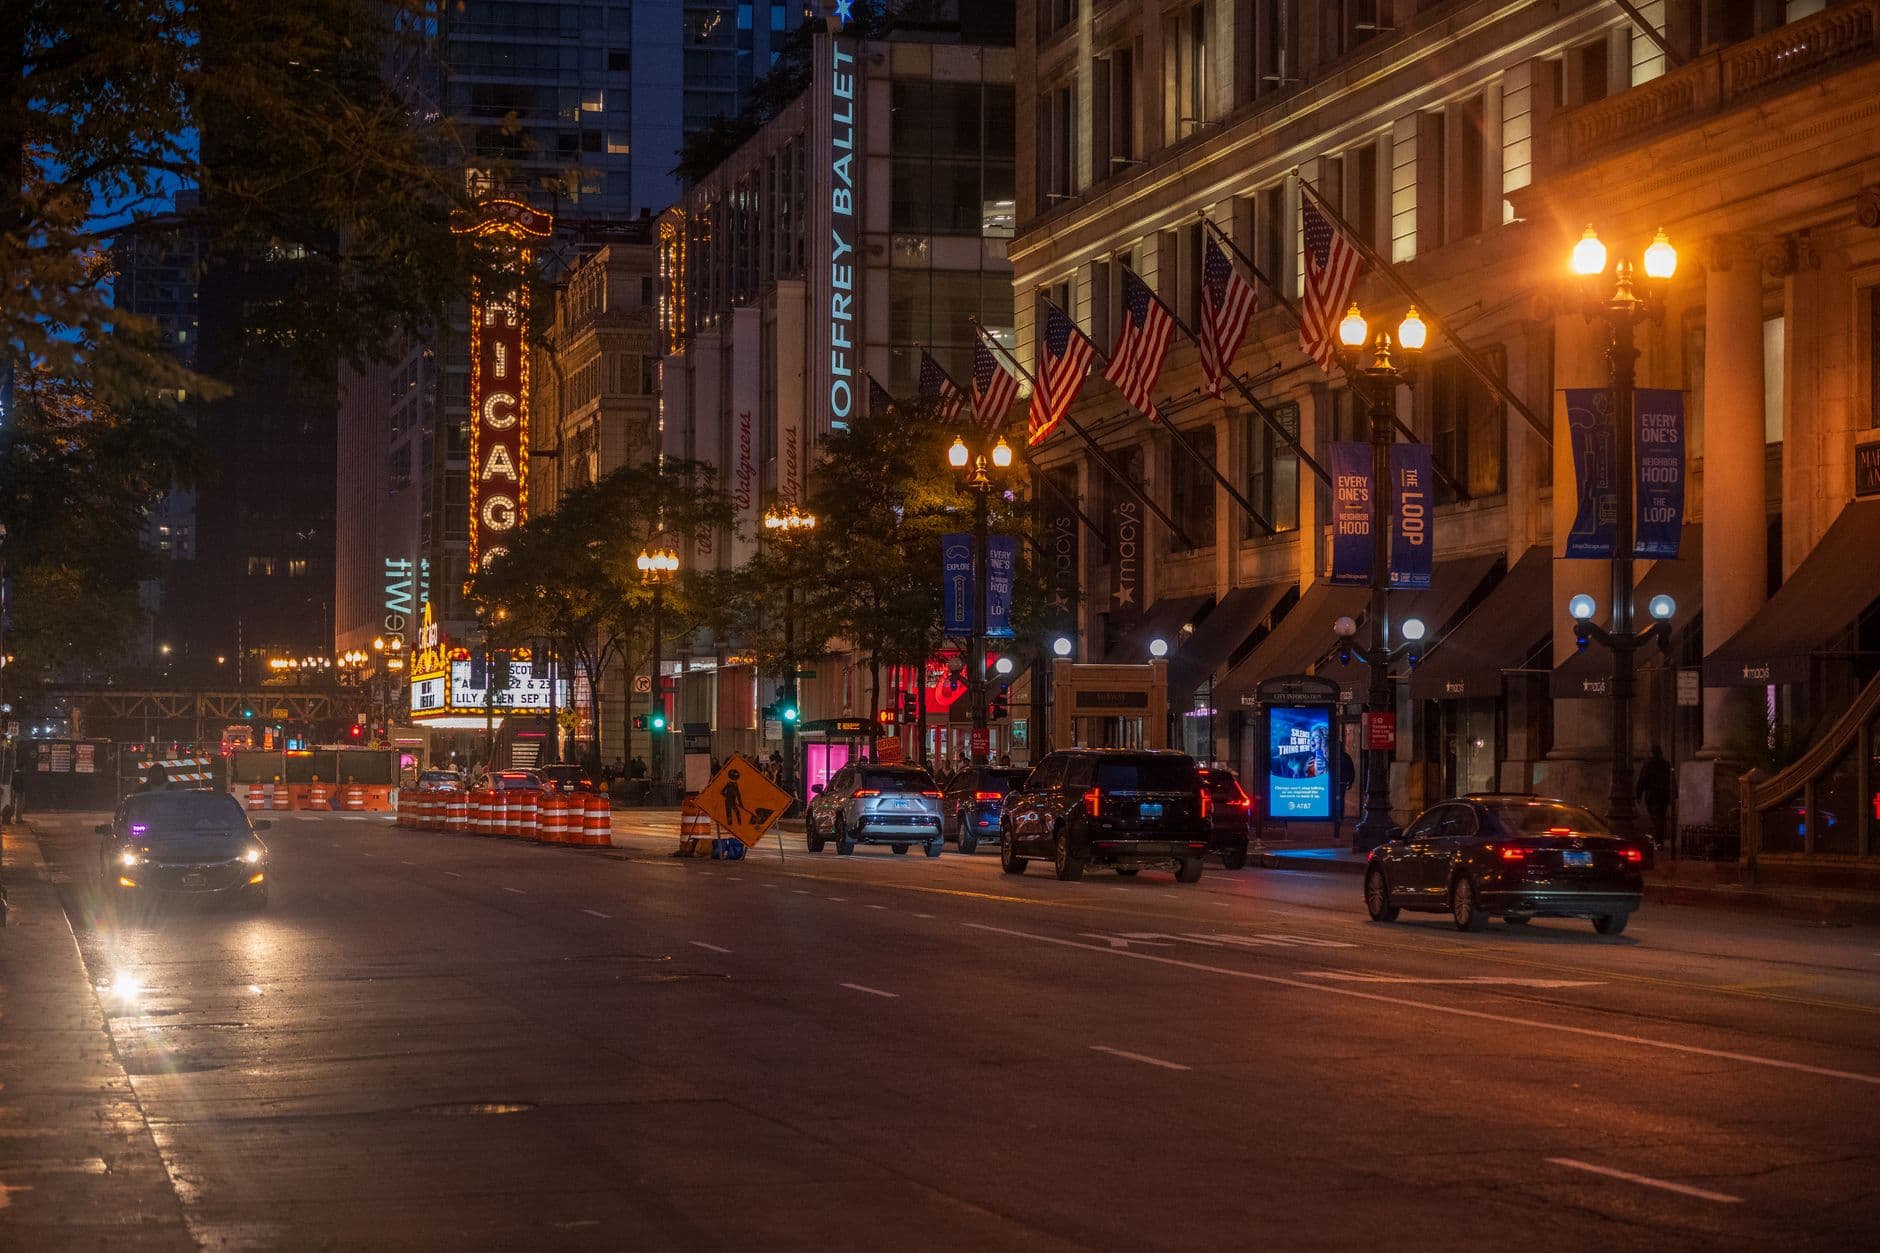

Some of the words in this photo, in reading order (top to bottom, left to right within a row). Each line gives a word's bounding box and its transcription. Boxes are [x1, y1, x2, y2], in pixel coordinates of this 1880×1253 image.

[832, 41, 855, 215] BALLET
[831, 232, 853, 434] JOFFREY
[481, 246, 517, 577] HICAG
[1641, 414, 1677, 427] EVERY
[1641, 428, 1678, 443] ONE'S
[732, 410, 757, 510] Walgreens
[1641, 458, 1678, 466] NEIGHBOR
[1338, 476, 1368, 487] EVERY
[1406, 469, 1418, 487] THE
[1641, 467, 1678, 483] HOOD
[1338, 488, 1369, 501] ONE'S
[1653, 497, 1666, 506] THE
[1401, 492, 1424, 546] LOOP
[1644, 507, 1676, 523] LOOP
[1339, 521, 1369, 535] HOOD
[989, 550, 1011, 560] EVERY
[946, 563, 972, 571] EXPLORE
[509, 680, 521, 689] 22
[527, 680, 534, 689] &
[539, 680, 551, 689] 23
[456, 694, 478, 703] LILY
[482, 694, 514, 703] AEN
[521, 694, 539, 703] SEP
[1290, 737, 1297, 745] IS
[1278, 745, 1299, 755] THING
